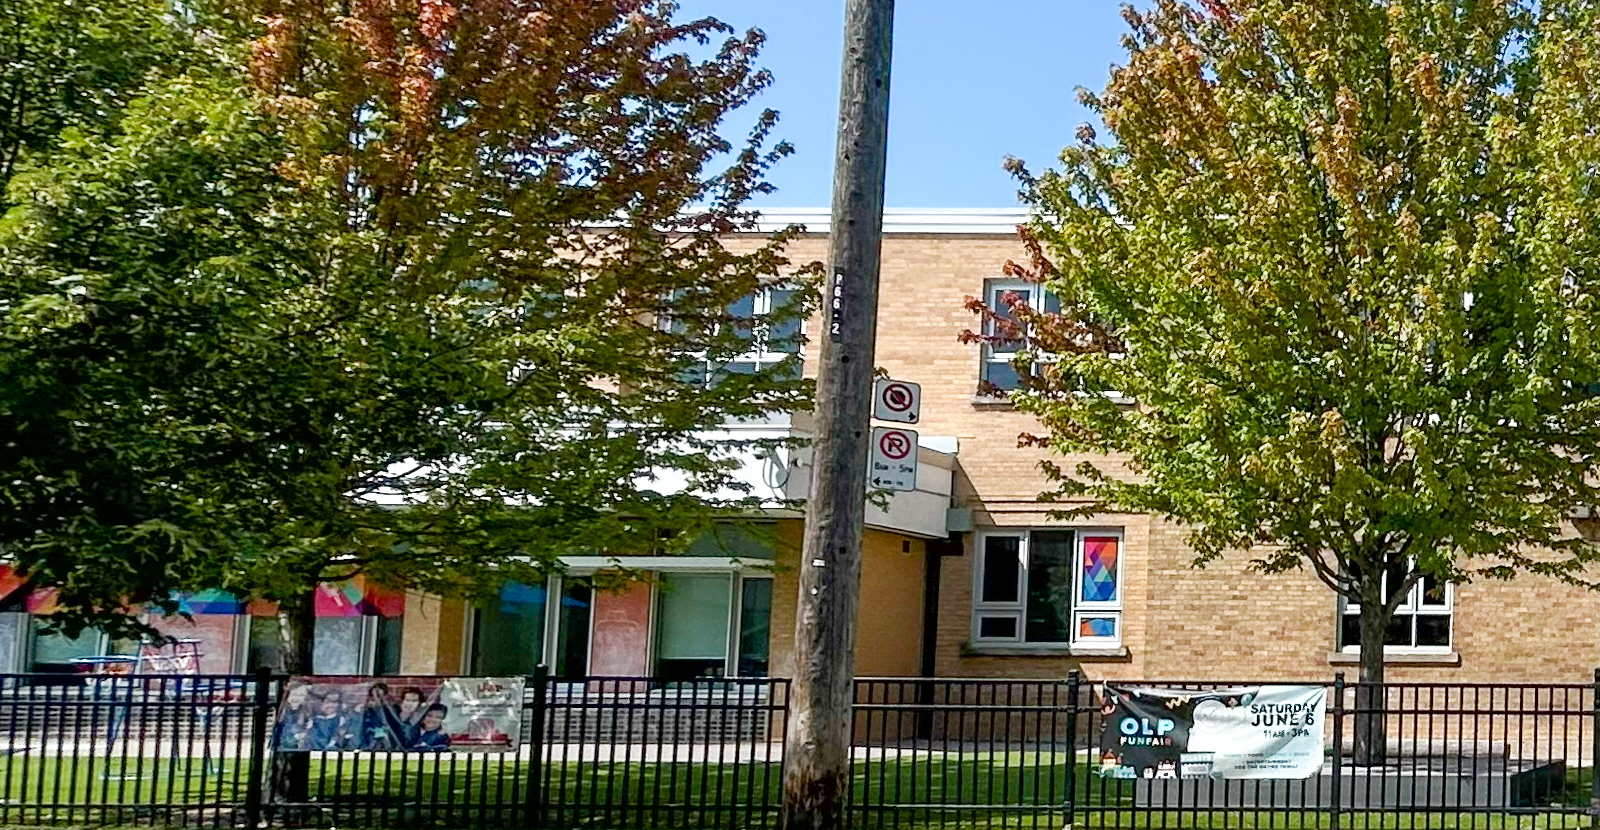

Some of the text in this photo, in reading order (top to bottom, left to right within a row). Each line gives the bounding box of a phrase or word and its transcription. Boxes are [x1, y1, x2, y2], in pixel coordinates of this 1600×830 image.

[1251, 703, 1316, 714] SATURDAY
[1251, 712, 1315, 726] JUNE 6
[1120, 717, 1175, 736] OLP
[1120, 736, 1172, 747] FUNFAIR
